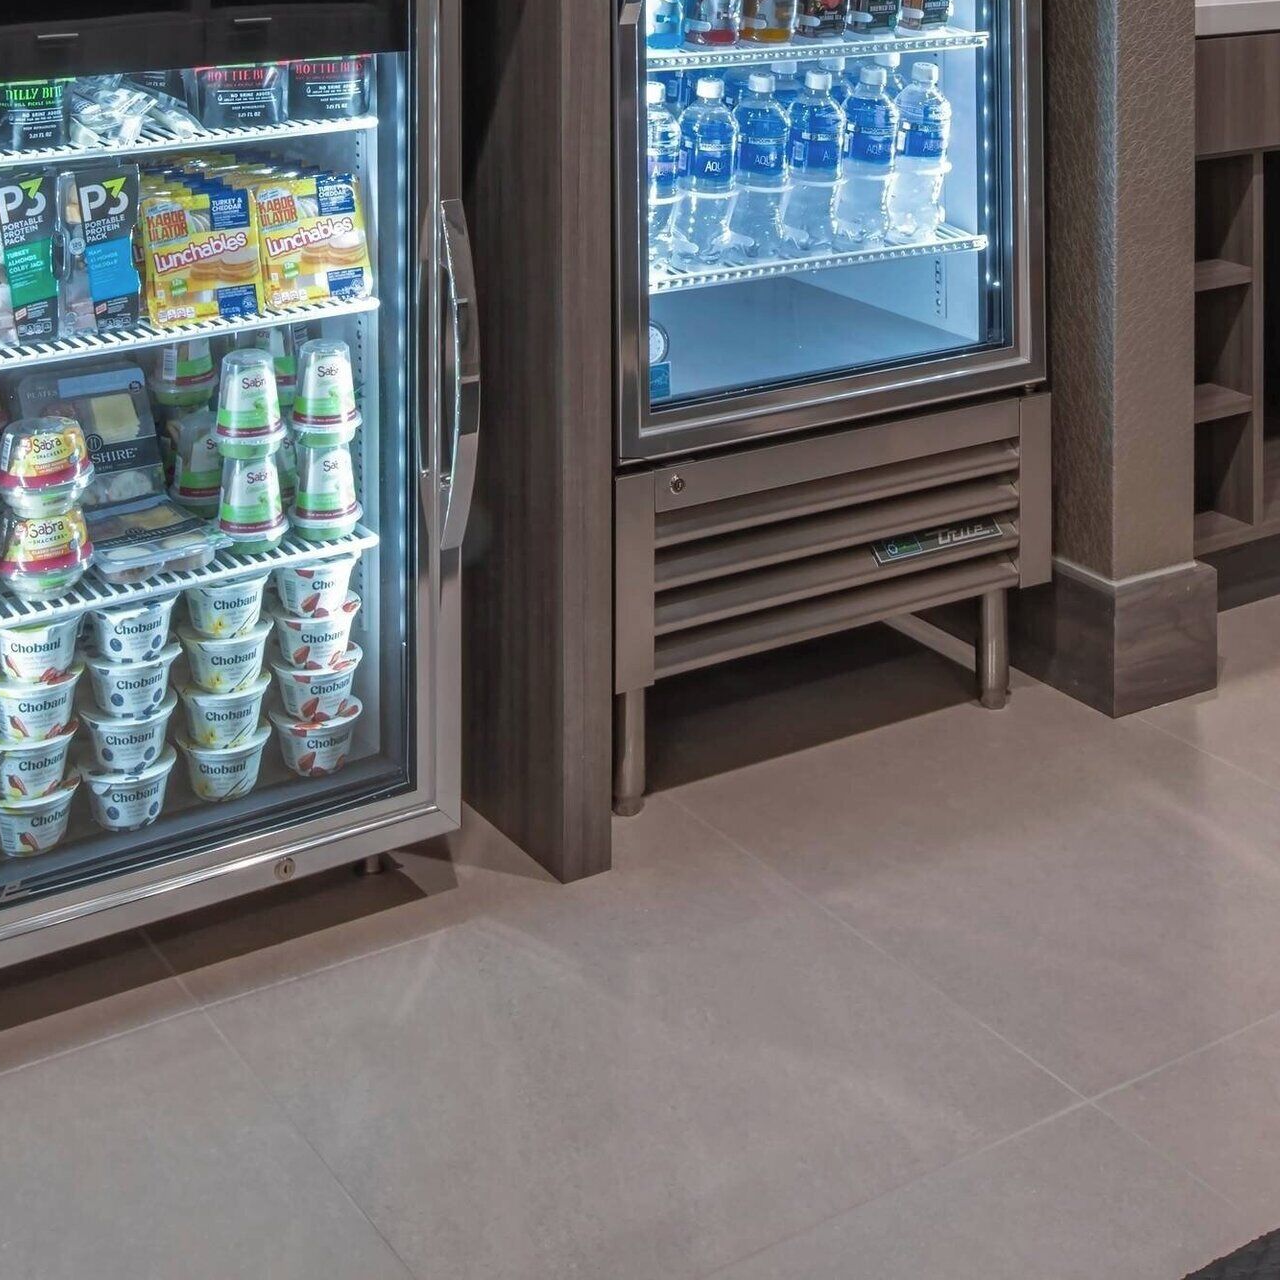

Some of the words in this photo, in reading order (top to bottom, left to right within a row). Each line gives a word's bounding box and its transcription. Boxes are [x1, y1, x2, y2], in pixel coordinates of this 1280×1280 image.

[79, 177, 129, 222] P3
[212, 204, 242, 212] CHEDDAR
[2, 216, 43, 231] PORTABLE
[85, 214, 125, 229] PORTABLE
[85, 223, 119, 236] PROTEIN
[3, 225, 38, 238] PROTEIN
[5, 235, 26, 246] PACK
[87, 233, 107, 243] PACK
[266, 217, 353, 257] Lunchables
[7, 248, 29, 259] TURKEY
[8, 255, 37, 267] ALMONDS
[154, 232, 248, 273] Lunchables
[32, 436, 62, 457] Sabra
[28, 520, 64, 540] Sabra
[213, 592, 258, 610] Chobani
[114, 615, 163, 637] Chobani
[10, 636, 61, 654] Chobani
[210, 648, 257, 666] Chobani
[116, 670, 163, 691] Chobani
[310, 681, 350, 697] Chobani
[18, 693, 68, 714] Chobani
[205, 705, 252, 723] Chobani
[105, 729, 155, 747] Chobani
[18, 750, 65, 772] Chobani
[199, 760, 246, 778] Chobani
[111, 784, 159, 805] Chobani
